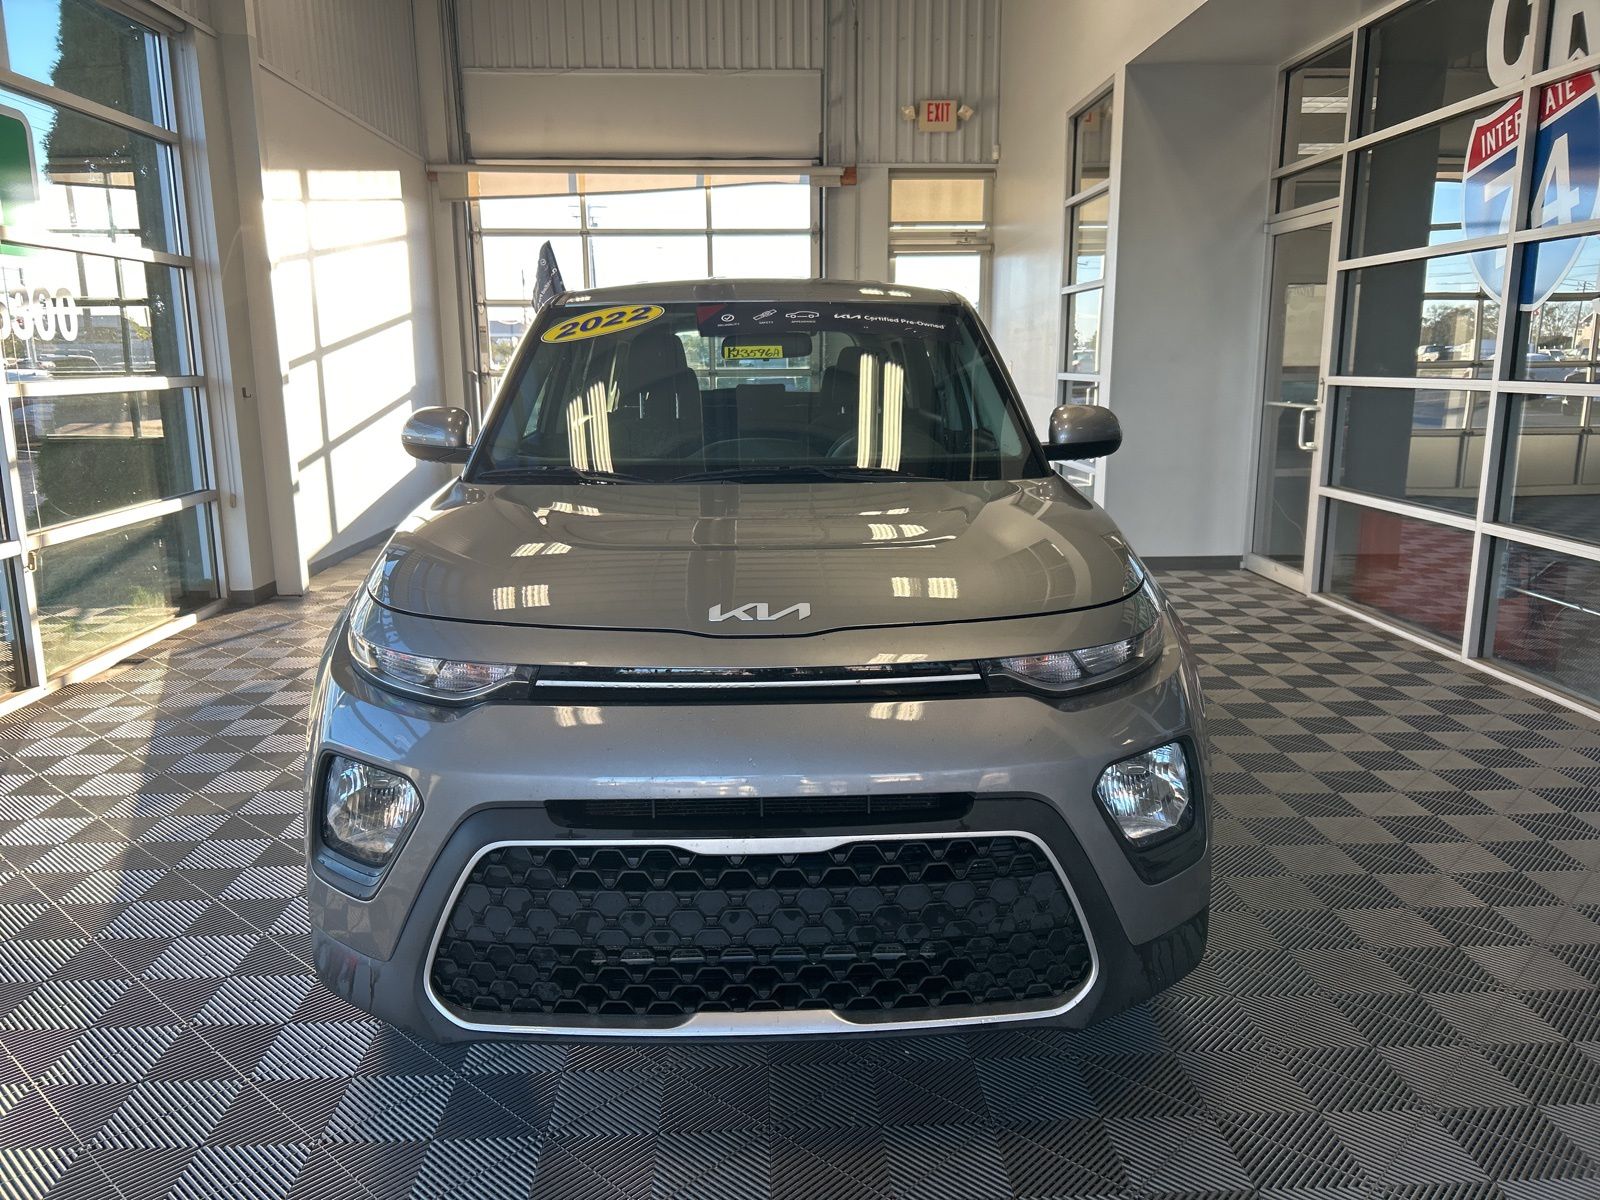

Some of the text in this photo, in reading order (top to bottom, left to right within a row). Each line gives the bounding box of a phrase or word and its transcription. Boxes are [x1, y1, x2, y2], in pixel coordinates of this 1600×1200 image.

[926, 102, 951, 122] EXIT
[1481, 81, 1576, 159] INTERATE
[554, 306, 654, 341] 2022
[864, 315, 899, 323] Certified
[900, 318, 945, 330] Pre-Owned
[708, 602, 811, 621] KIA
